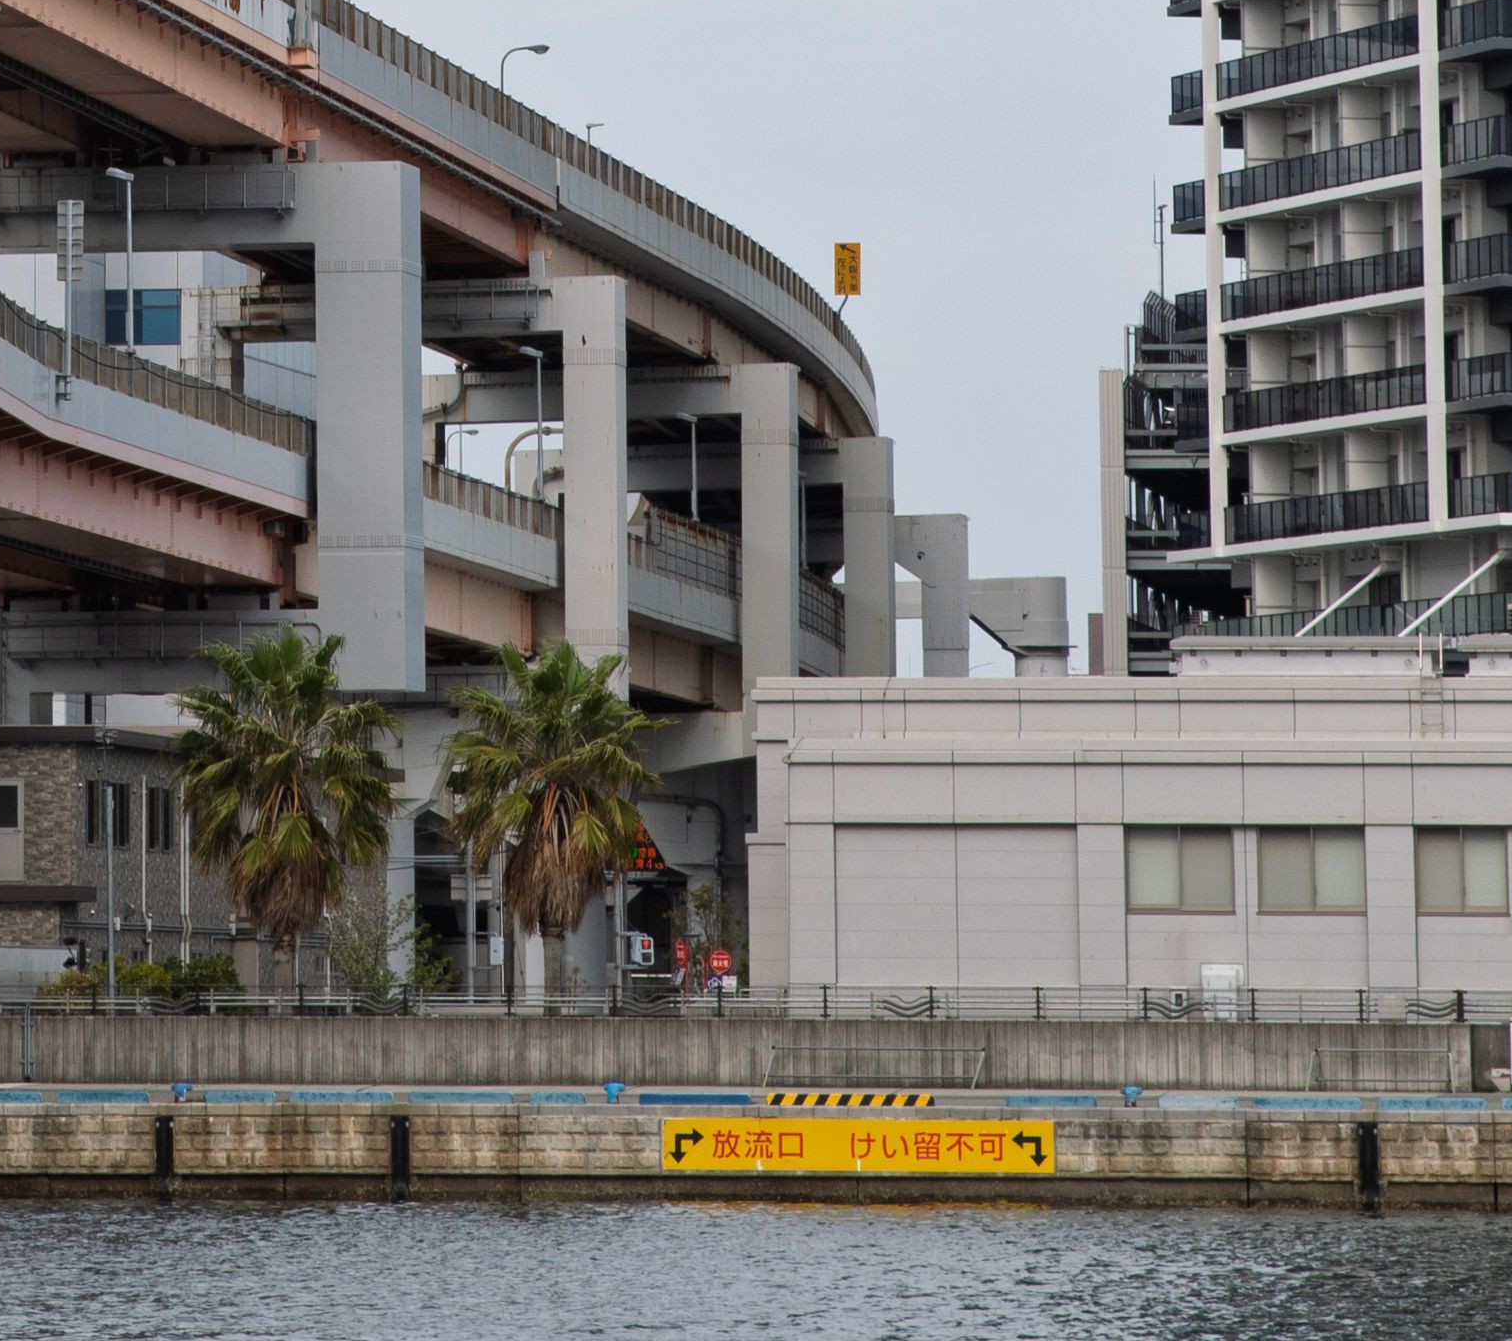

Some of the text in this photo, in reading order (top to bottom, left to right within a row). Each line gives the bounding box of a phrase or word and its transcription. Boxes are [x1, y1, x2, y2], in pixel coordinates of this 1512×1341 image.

[711, 1130, 805, 1159] 放流口
[850, 1131, 1007, 1162] けい留不可
